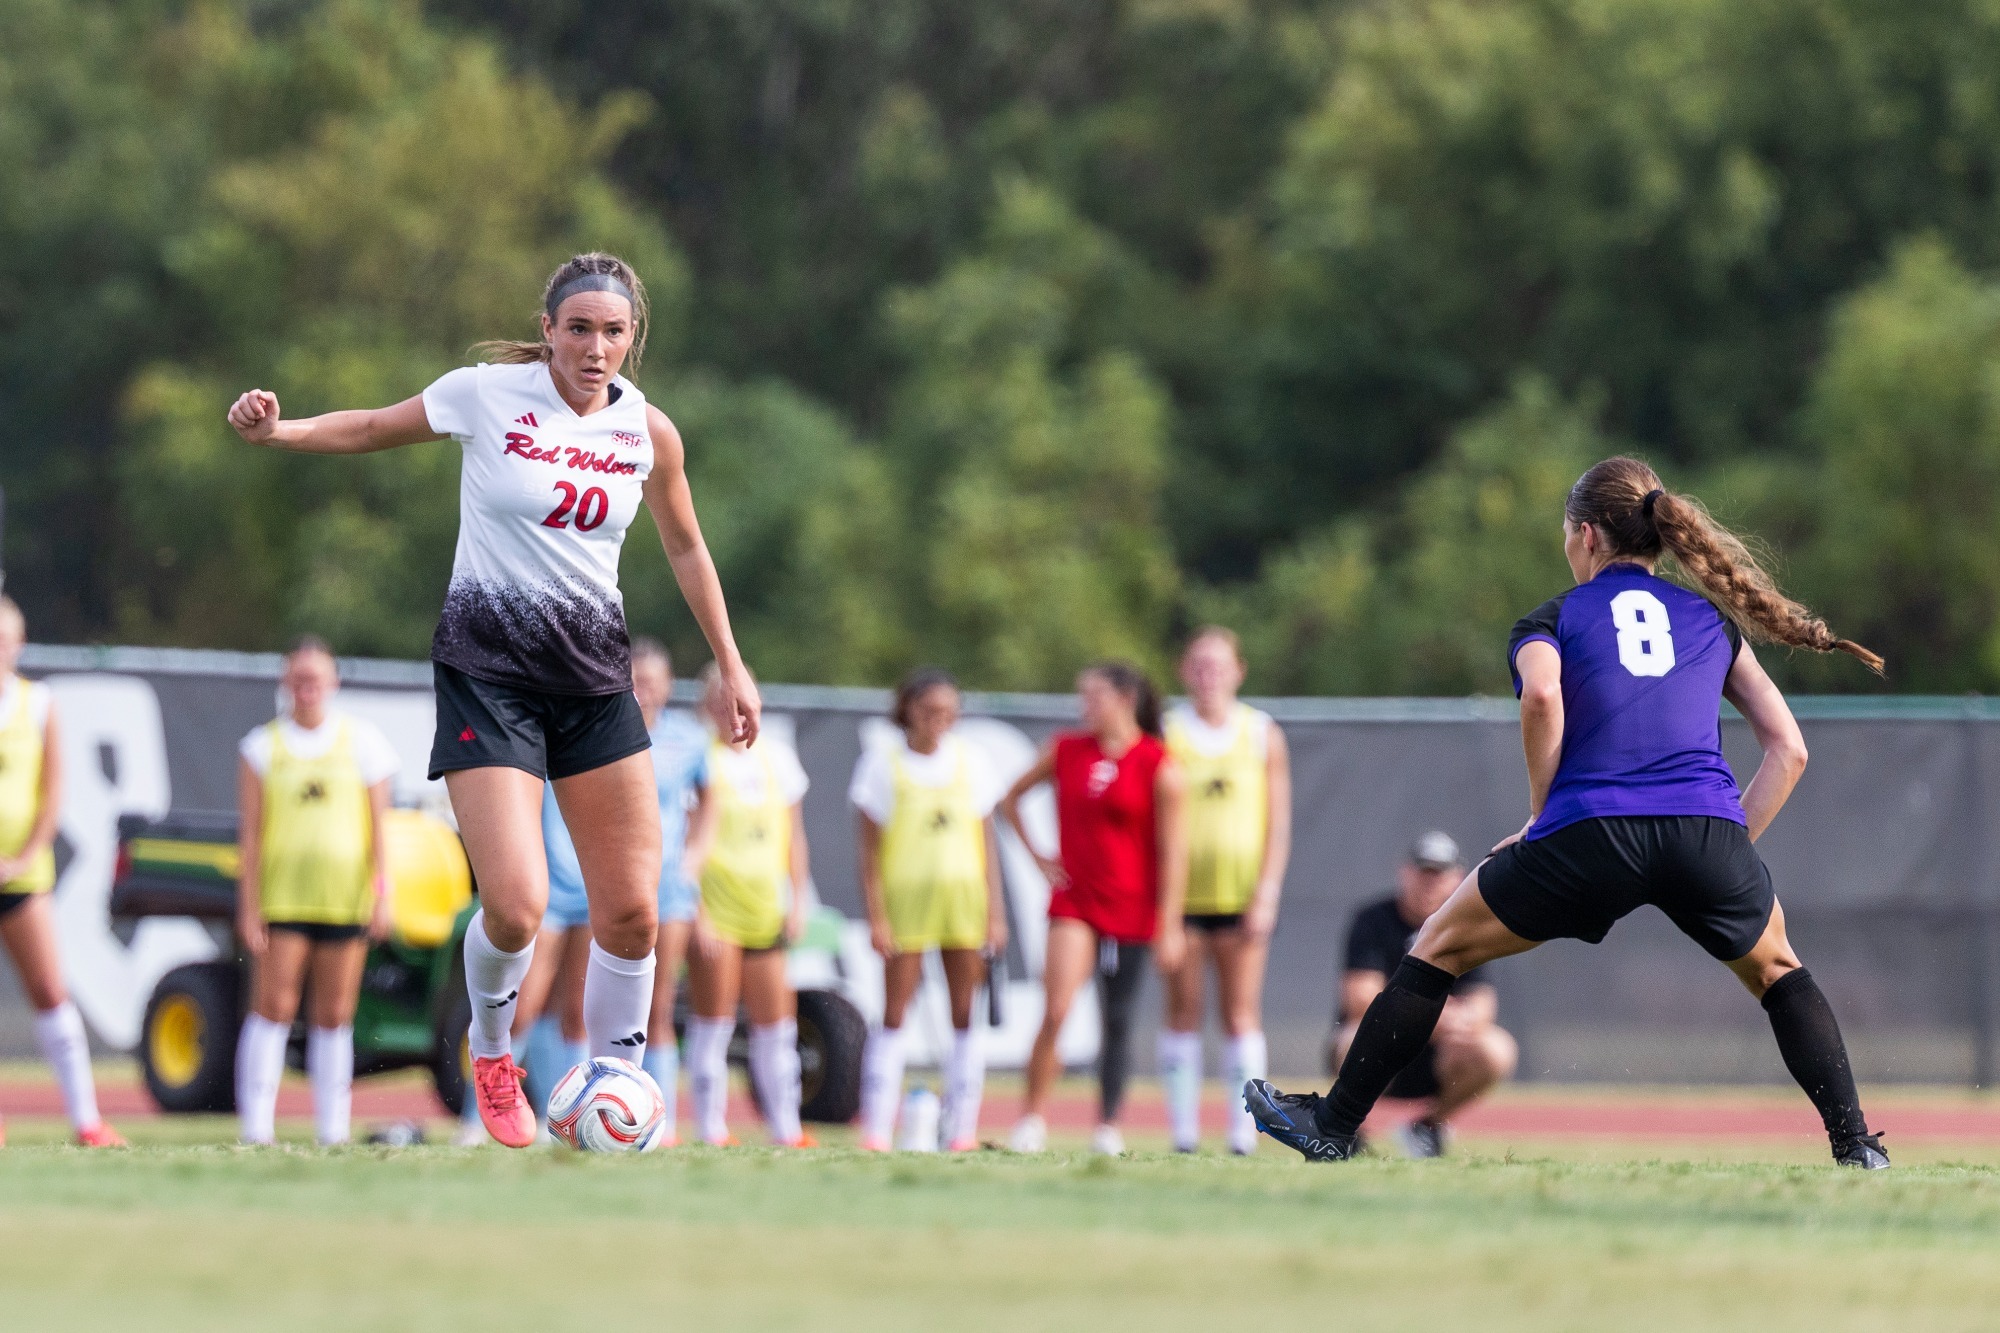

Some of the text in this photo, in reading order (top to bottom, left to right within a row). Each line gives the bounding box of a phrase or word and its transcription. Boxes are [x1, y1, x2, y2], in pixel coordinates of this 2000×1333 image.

[504, 431, 561, 464] Red
[540, 480, 609, 532] 20
[1609, 589, 1676, 677] 8
